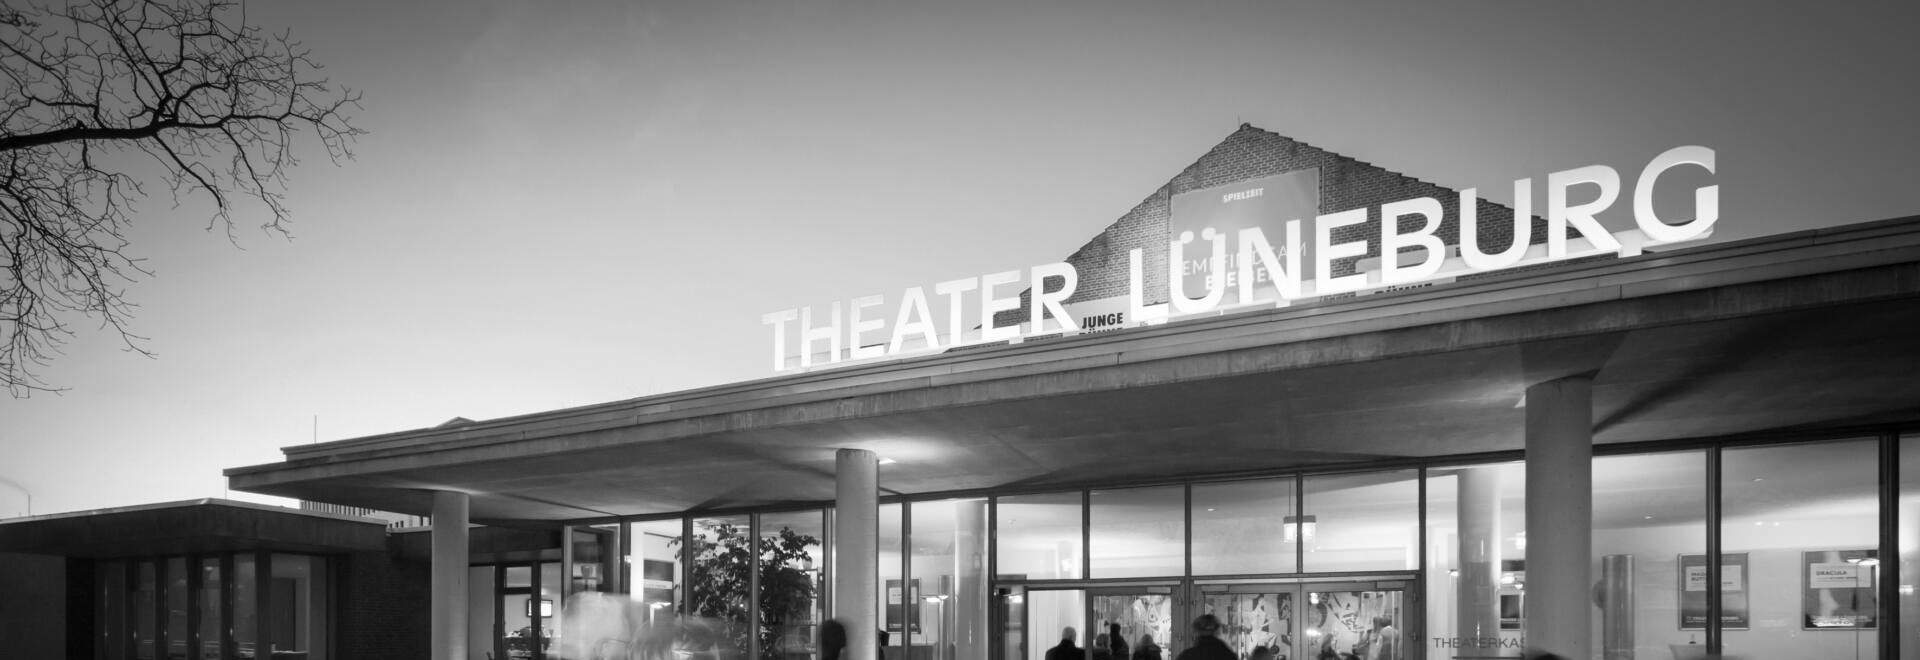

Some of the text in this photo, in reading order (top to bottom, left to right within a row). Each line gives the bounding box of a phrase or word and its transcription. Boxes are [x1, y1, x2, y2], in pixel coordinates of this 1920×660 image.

[1223, 188, 1264, 203] SPIELZEIT
[762, 145, 1718, 371] THEATER LÜNEBURG
[1082, 312, 1123, 329] JUNGE
